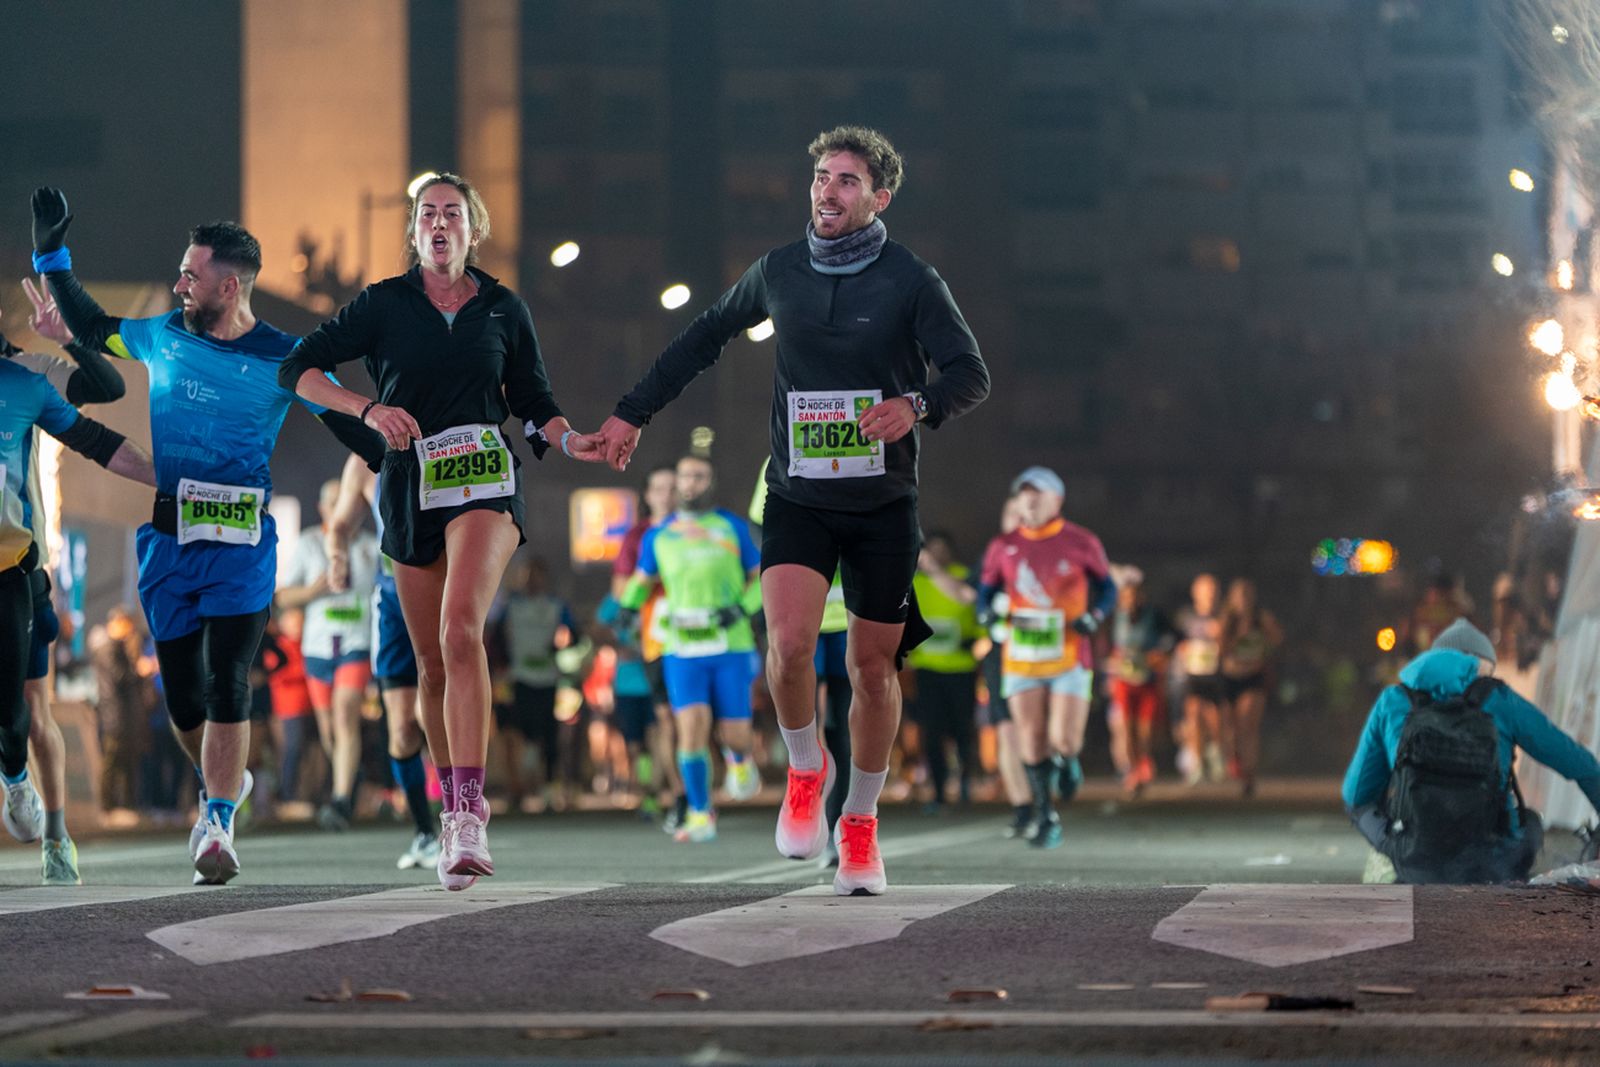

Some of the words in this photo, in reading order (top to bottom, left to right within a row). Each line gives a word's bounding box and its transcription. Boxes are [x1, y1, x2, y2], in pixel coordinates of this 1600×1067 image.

[807, 401, 833, 410] NOCHE
[834, 400, 846, 410] DE
[798, 412, 816, 421] SAN
[437, 436, 463, 449] NOCHE
[464, 434, 474, 443] DE
[429, 449, 448, 459] SAN
[432, 450, 501, 481] 12393
[196, 490, 220, 500] NOCHE
[222, 493, 232, 502] DE
[192, 500, 246, 522] 8635
